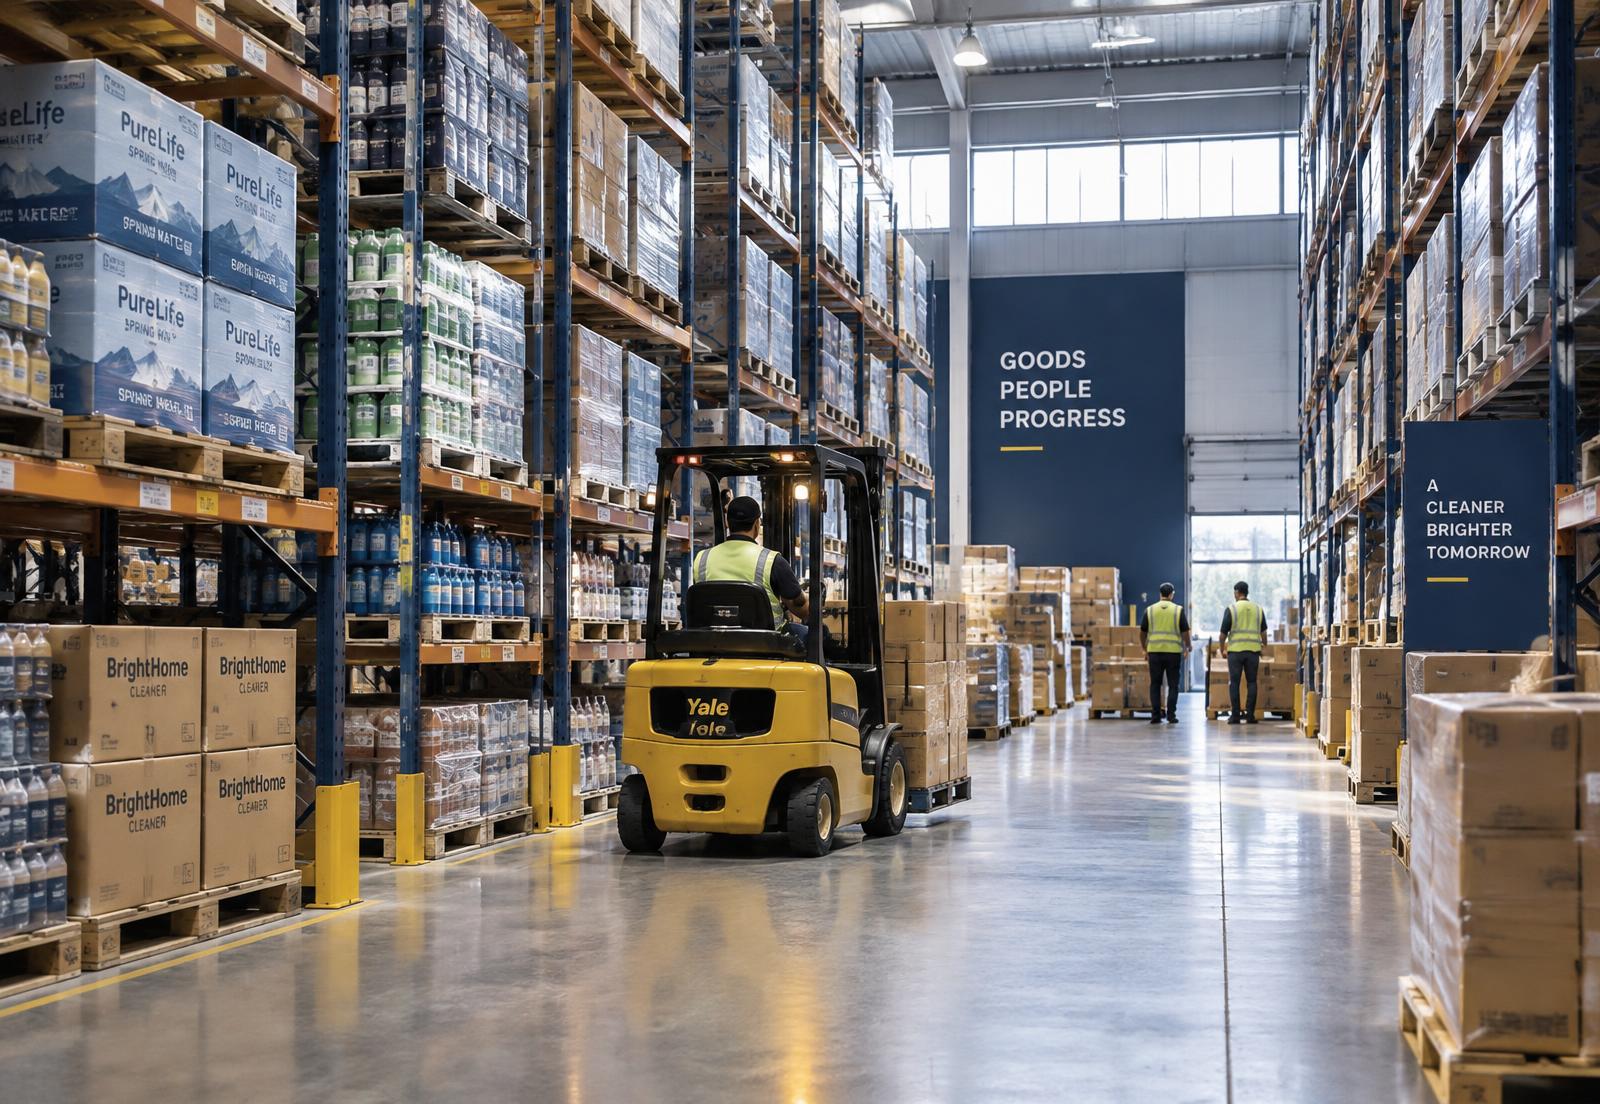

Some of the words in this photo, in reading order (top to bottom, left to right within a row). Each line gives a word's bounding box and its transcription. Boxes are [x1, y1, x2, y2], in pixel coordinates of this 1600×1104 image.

[121, 110, 185, 162] PureLife
[227, 163, 282, 209] PureLife
[118, 284, 184, 328] PureLife
[225, 320, 281, 357] PureLife
[1000, 350, 1086, 370] GOODS
[1000, 380, 1092, 399] PEOPLE
[1000, 408, 1126, 428] PROGRESS
[1427, 479, 1439, 492] A
[1427, 501, 1505, 514] CLEANER
[1427, 523, 1512, 537] BRIGHTER
[1427, 545, 1531, 559] TOMORROW
[107, 657, 189, 682] BrightHome
[220, 656, 286, 679] BrightHome
[687, 698, 729, 716] Yale
[219, 774, 286, 801] BrightHome
[106, 788, 188, 818] BrightHome
